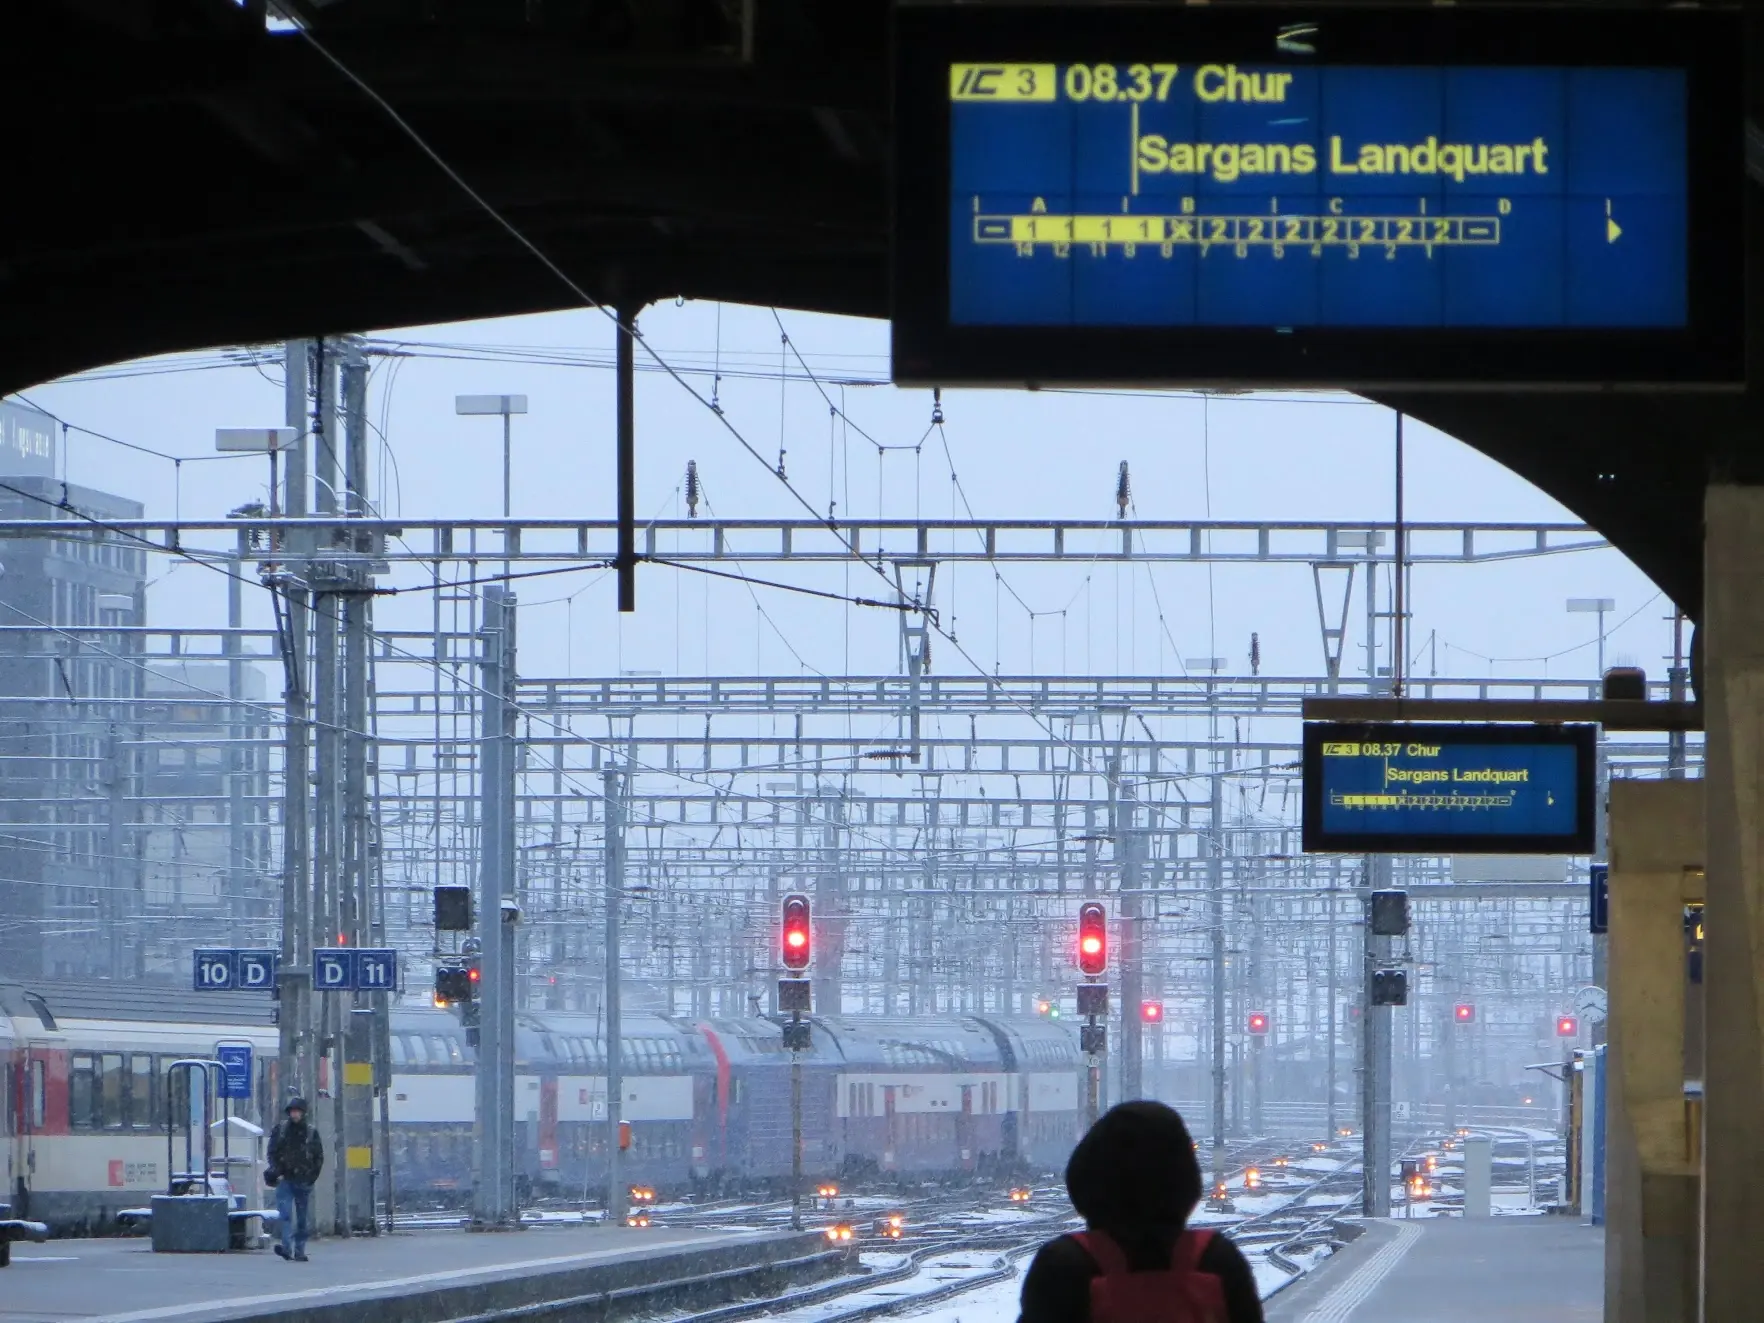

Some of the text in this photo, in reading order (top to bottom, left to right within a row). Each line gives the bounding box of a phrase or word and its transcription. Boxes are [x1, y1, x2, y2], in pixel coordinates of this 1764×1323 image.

[958, 64, 1292, 103] IC 3 08.37 Chur
[1138, 136, 1549, 183] Sargans Landquart
[1031, 197, 1047, 213] A
[1330, 199, 1343, 214] C
[1028, 219, 1450, 241] 1 1 1 1 2 2 2 2 2 2 2
[1345, 744, 1353, 754] 3
[1362, 744, 1401, 756] 08.37
[1407, 743, 1441, 756] Chur
[1387, 768, 1528, 784] Sargans Landquart
[200, 963, 265, 984] 10 D
[325, 963, 385, 984] D 11
